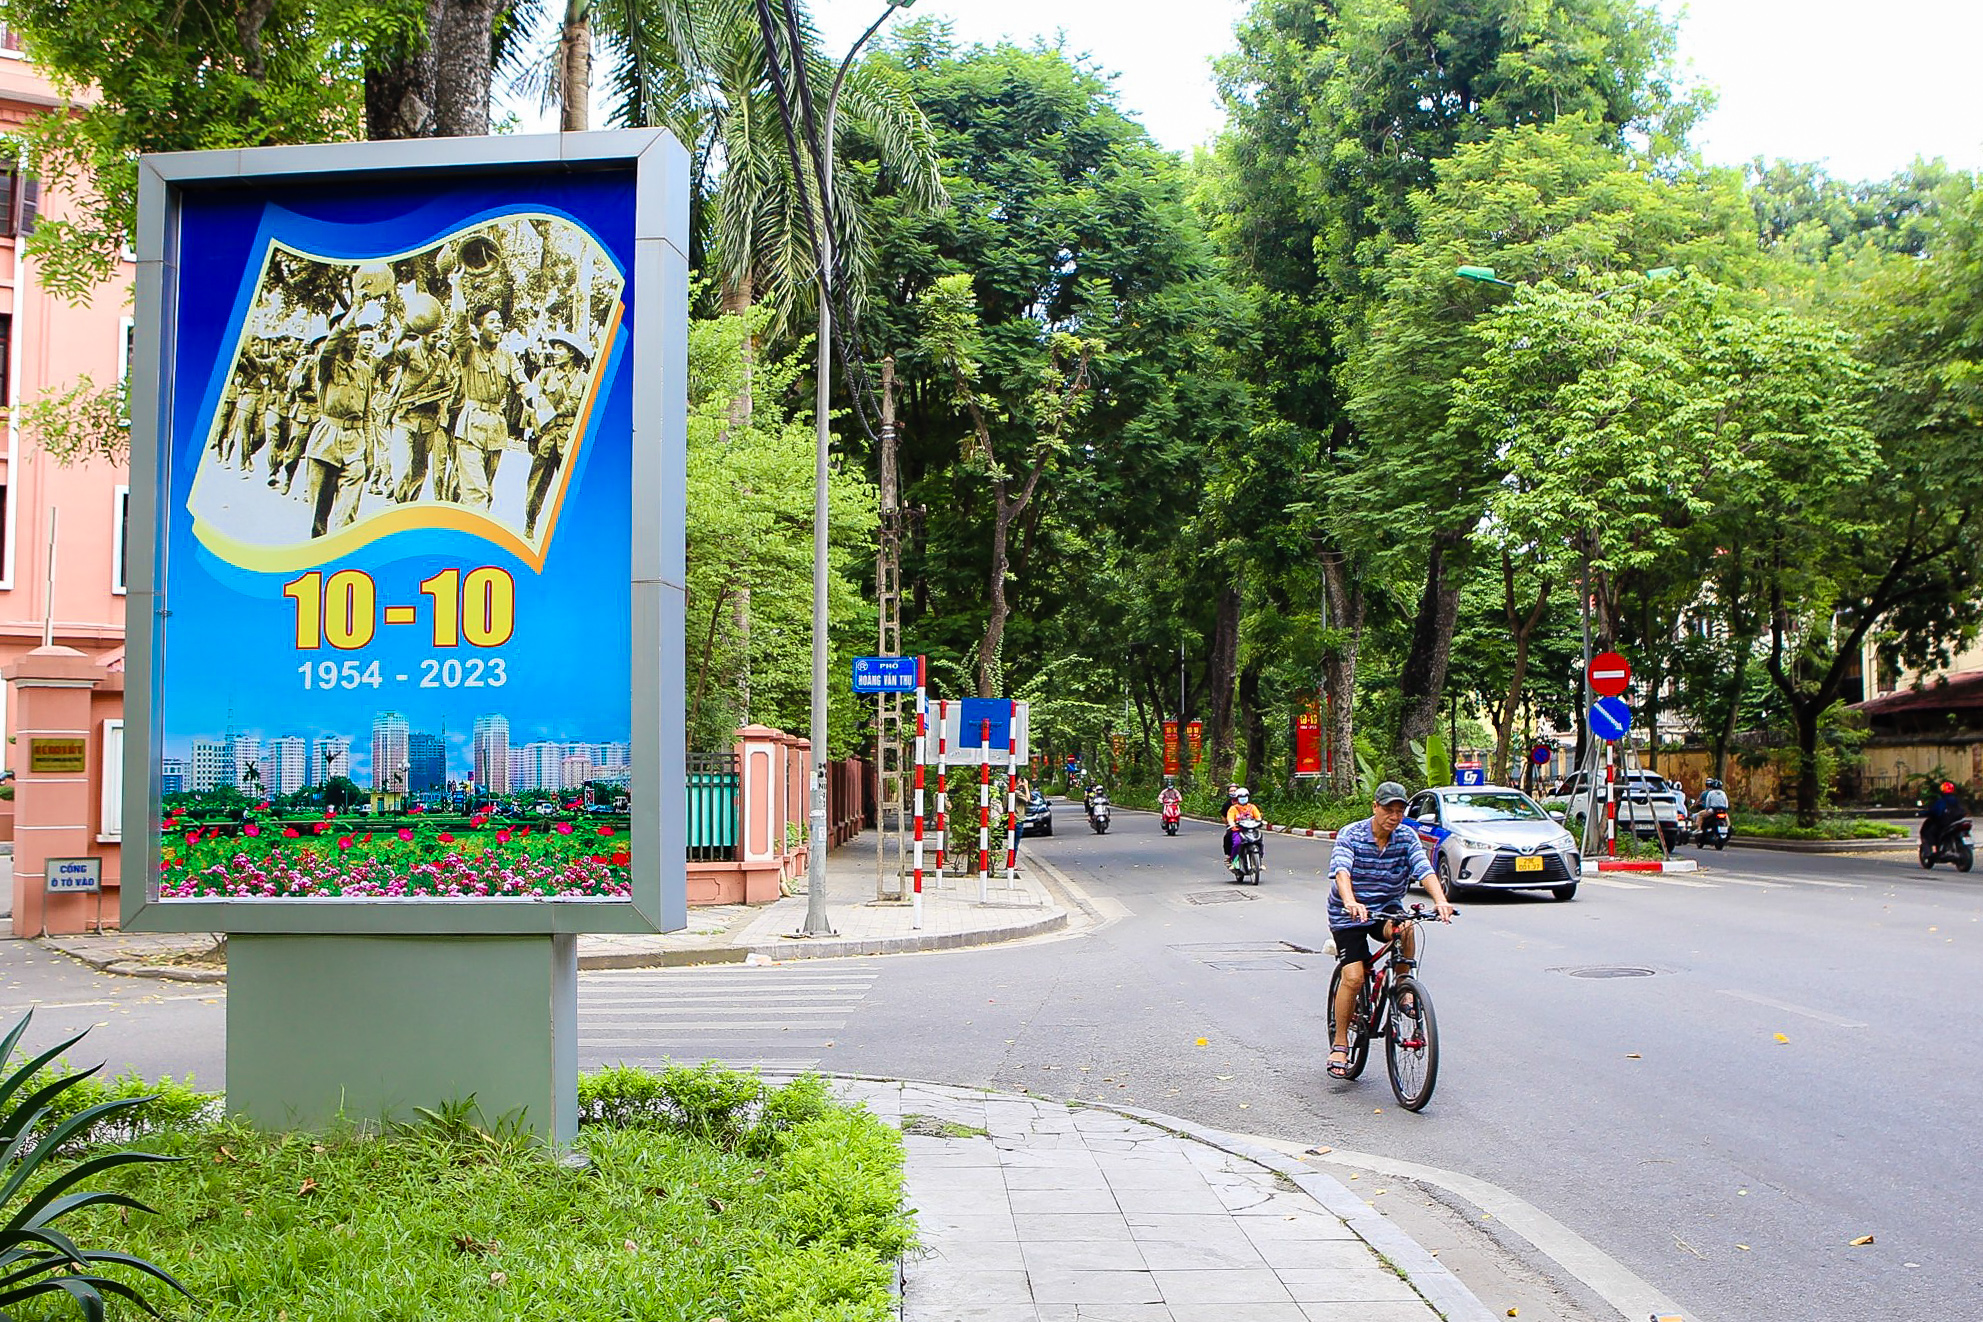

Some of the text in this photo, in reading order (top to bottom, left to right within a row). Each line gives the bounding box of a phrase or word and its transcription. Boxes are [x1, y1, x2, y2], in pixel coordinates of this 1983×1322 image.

[879, 660, 899, 670] PHỐ
[298, 660, 382, 690] 1954
[419, 658, 507, 688] 2023
[858, 671, 913, 690] HOÀNG VĂN THỤ
[75, 876, 95, 886] VÀO
